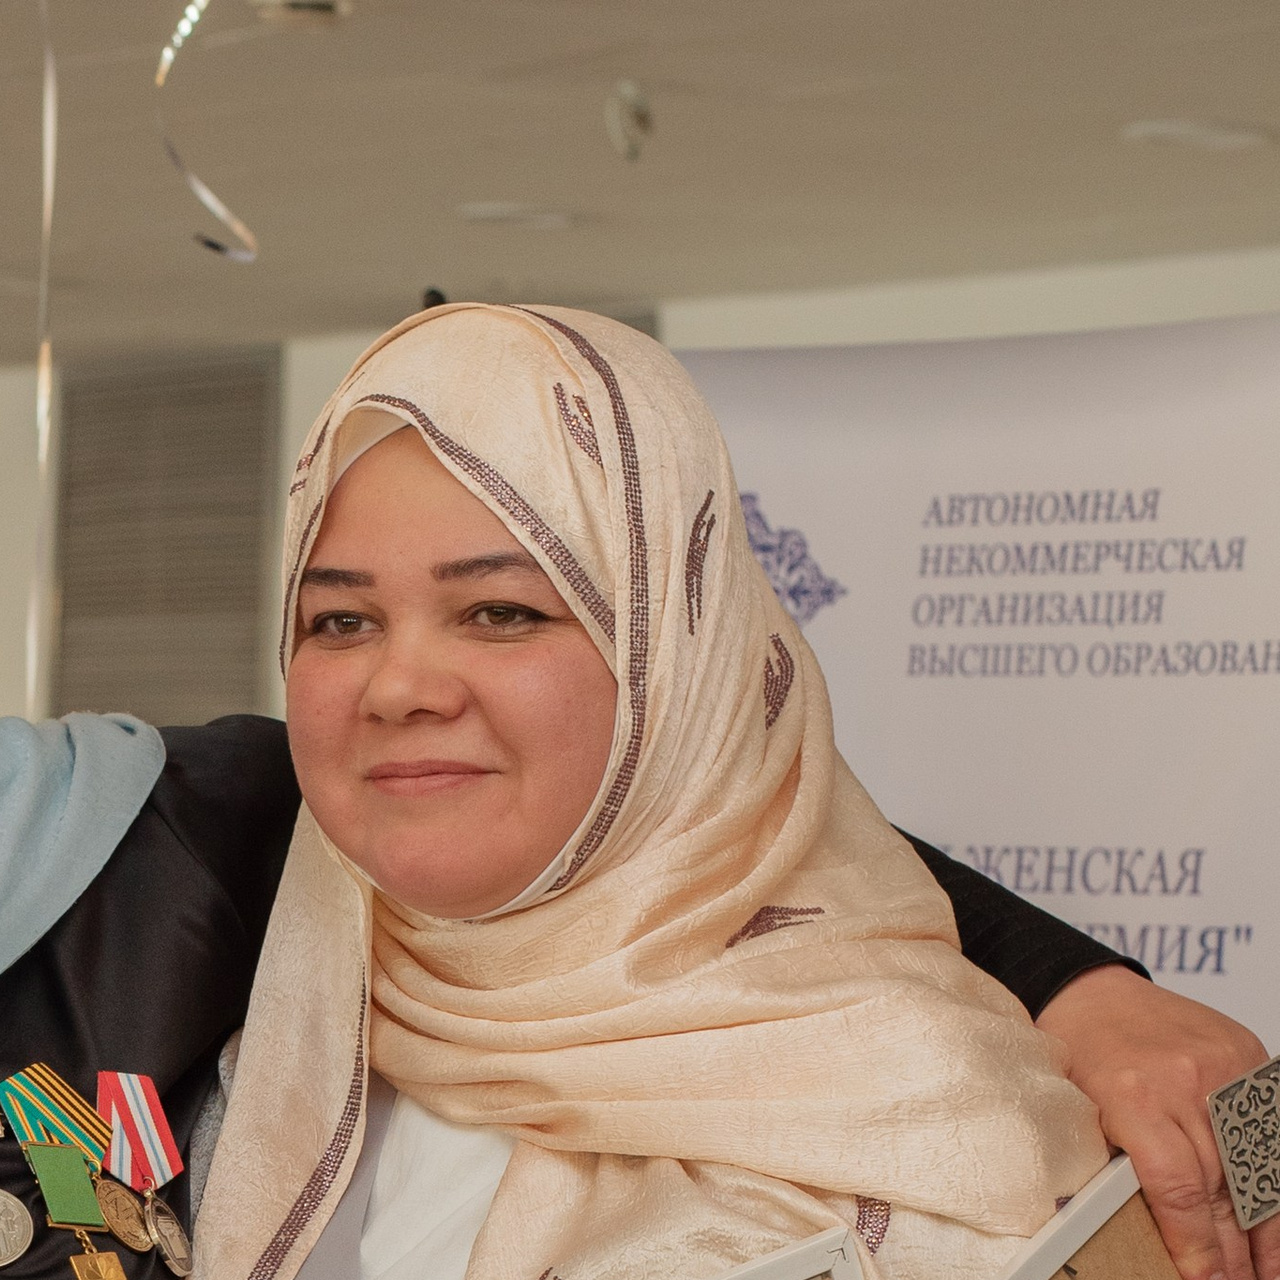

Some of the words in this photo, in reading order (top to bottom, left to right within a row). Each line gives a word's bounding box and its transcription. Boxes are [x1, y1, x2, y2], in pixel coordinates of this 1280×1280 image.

[923, 488, 1161, 528] АВТОНОМНАЯ
[919, 536, 1246, 577] НЕКОММЕРЧЕСКАЯ
[910, 589, 1165, 629] ОРГАНИЗАЦИЯ
[907, 642, 1079, 678] ВЫСШЕГО
[969, 846, 1205, 897] ЖЕНСКАЯ
